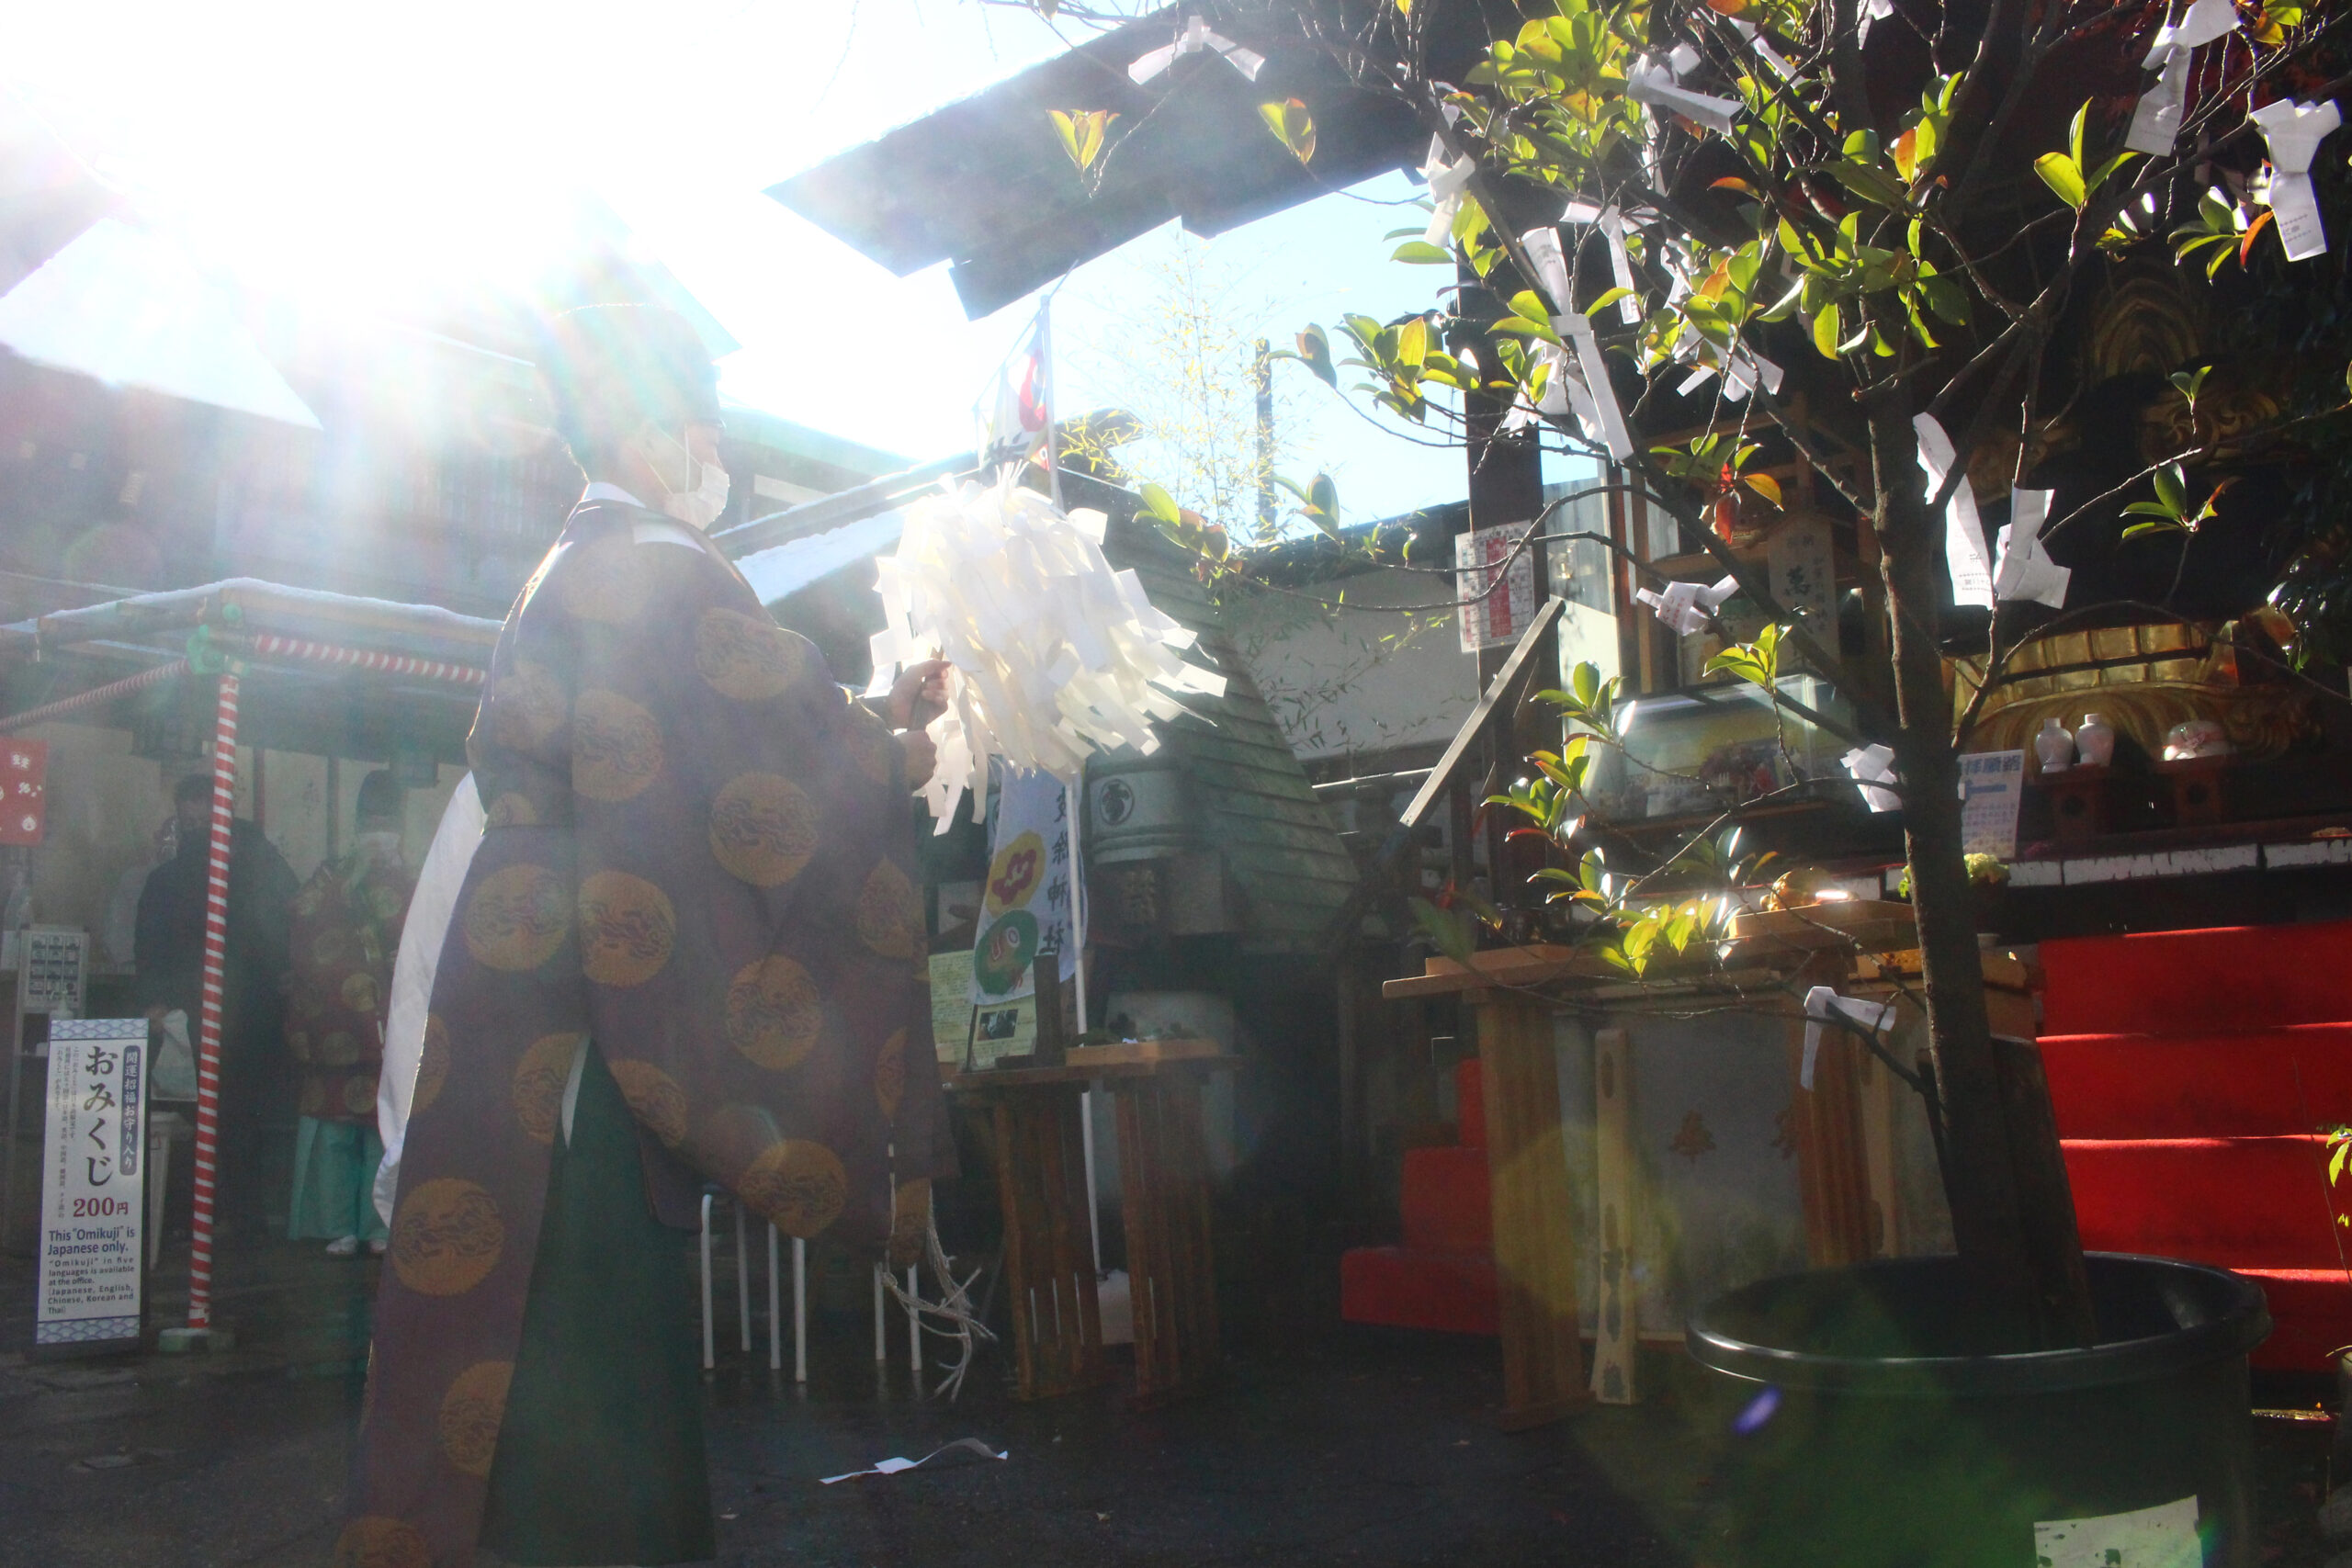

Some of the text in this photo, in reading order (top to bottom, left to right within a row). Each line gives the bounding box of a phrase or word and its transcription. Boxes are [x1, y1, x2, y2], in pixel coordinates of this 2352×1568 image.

[83, 1045, 119, 1187] おみくじ
[122, 1051, 139, 1170] 開運招福お守り入り
[74, 1197, 129, 1217] 200円
[49, 1226, 135, 1241] This "Omikuji" is
[48, 1241, 129, 1257] Japanese only.
[49, 1269, 89, 1277] languages
[99, 1266, 135, 1274] available
[72, 1277, 96, 1285] office.
[98, 1285, 134, 1293] English,
[48, 1292, 134, 1304] Chinese, Korean and
